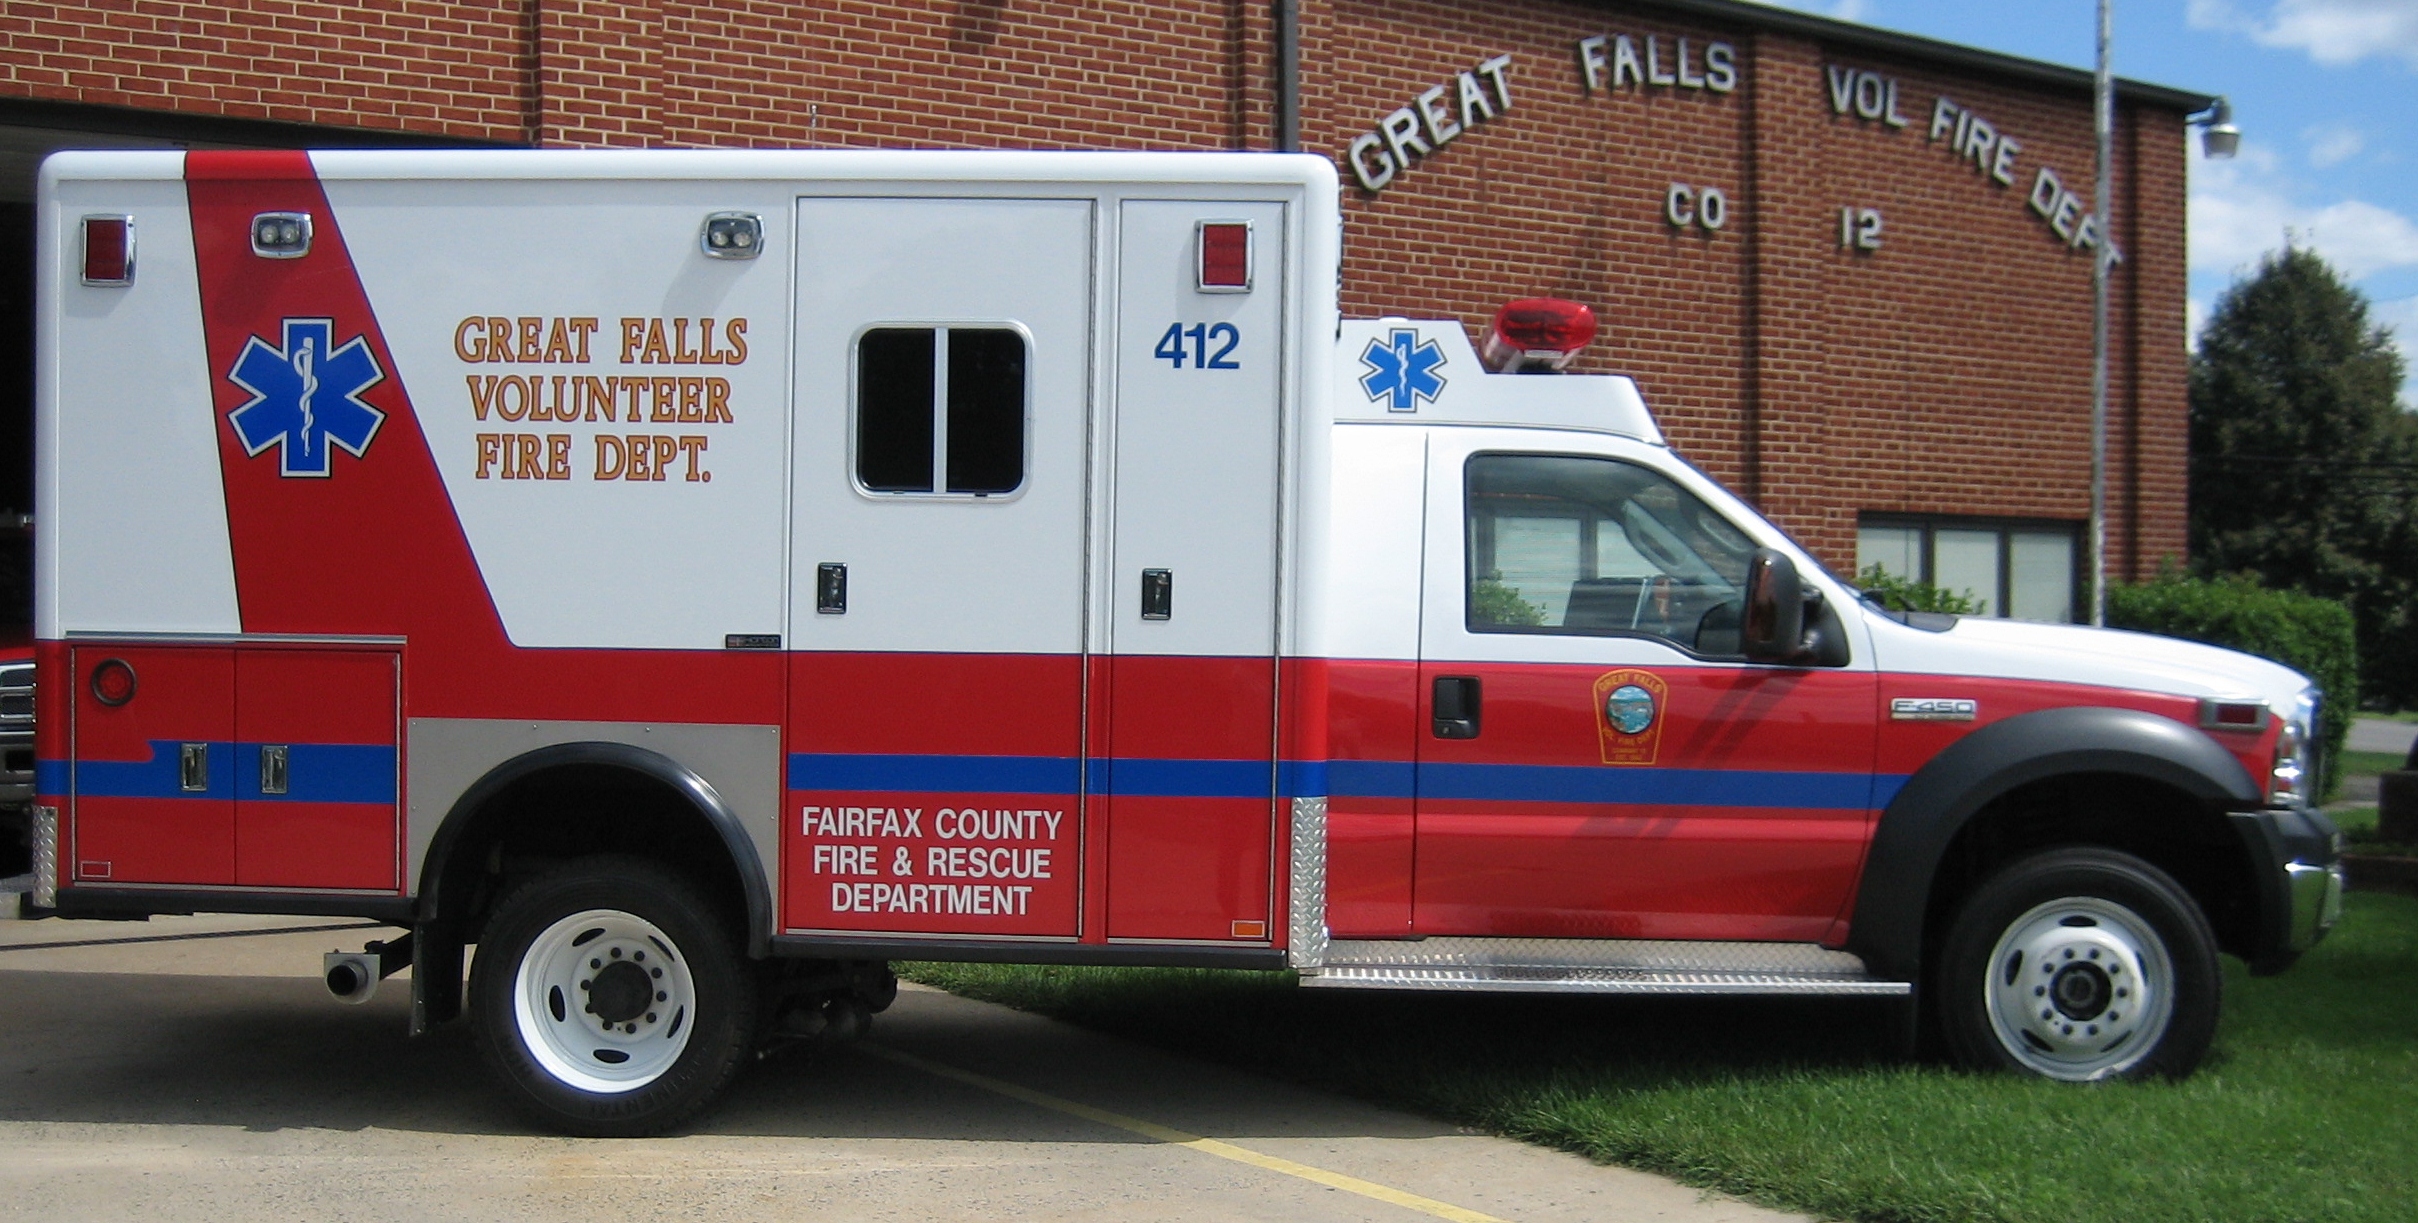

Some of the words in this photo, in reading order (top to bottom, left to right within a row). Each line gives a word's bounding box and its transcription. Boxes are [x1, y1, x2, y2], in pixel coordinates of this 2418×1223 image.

[1348, 53, 1512, 192] GREAT
[1579, 34, 1737, 93] FALLS
[1826, 64, 1910, 128] VOL
[1930, 97, 2021, 186] FIRE
[1667, 181, 1726, 231] CO
[1840, 206, 1884, 250] 12
[454, 315, 598, 364] GREAT
[619, 317, 749, 366] FALLS
[1153, 321, 1240, 370] 412
[466, 374, 734, 424] VOLUNTEER
[475, 433, 572, 480] FIRE
[593, 434, 712, 483] DEPT.
[801, 805, 923, 838] FAIRFAX
[934, 807, 1063, 841] COUNTY
[813, 844, 878, 875] FIRE
[892, 845, 913, 877] &
[927, 846, 1052, 879] RESCUE
[831, 881, 1033, 916] DEPARTMENT
